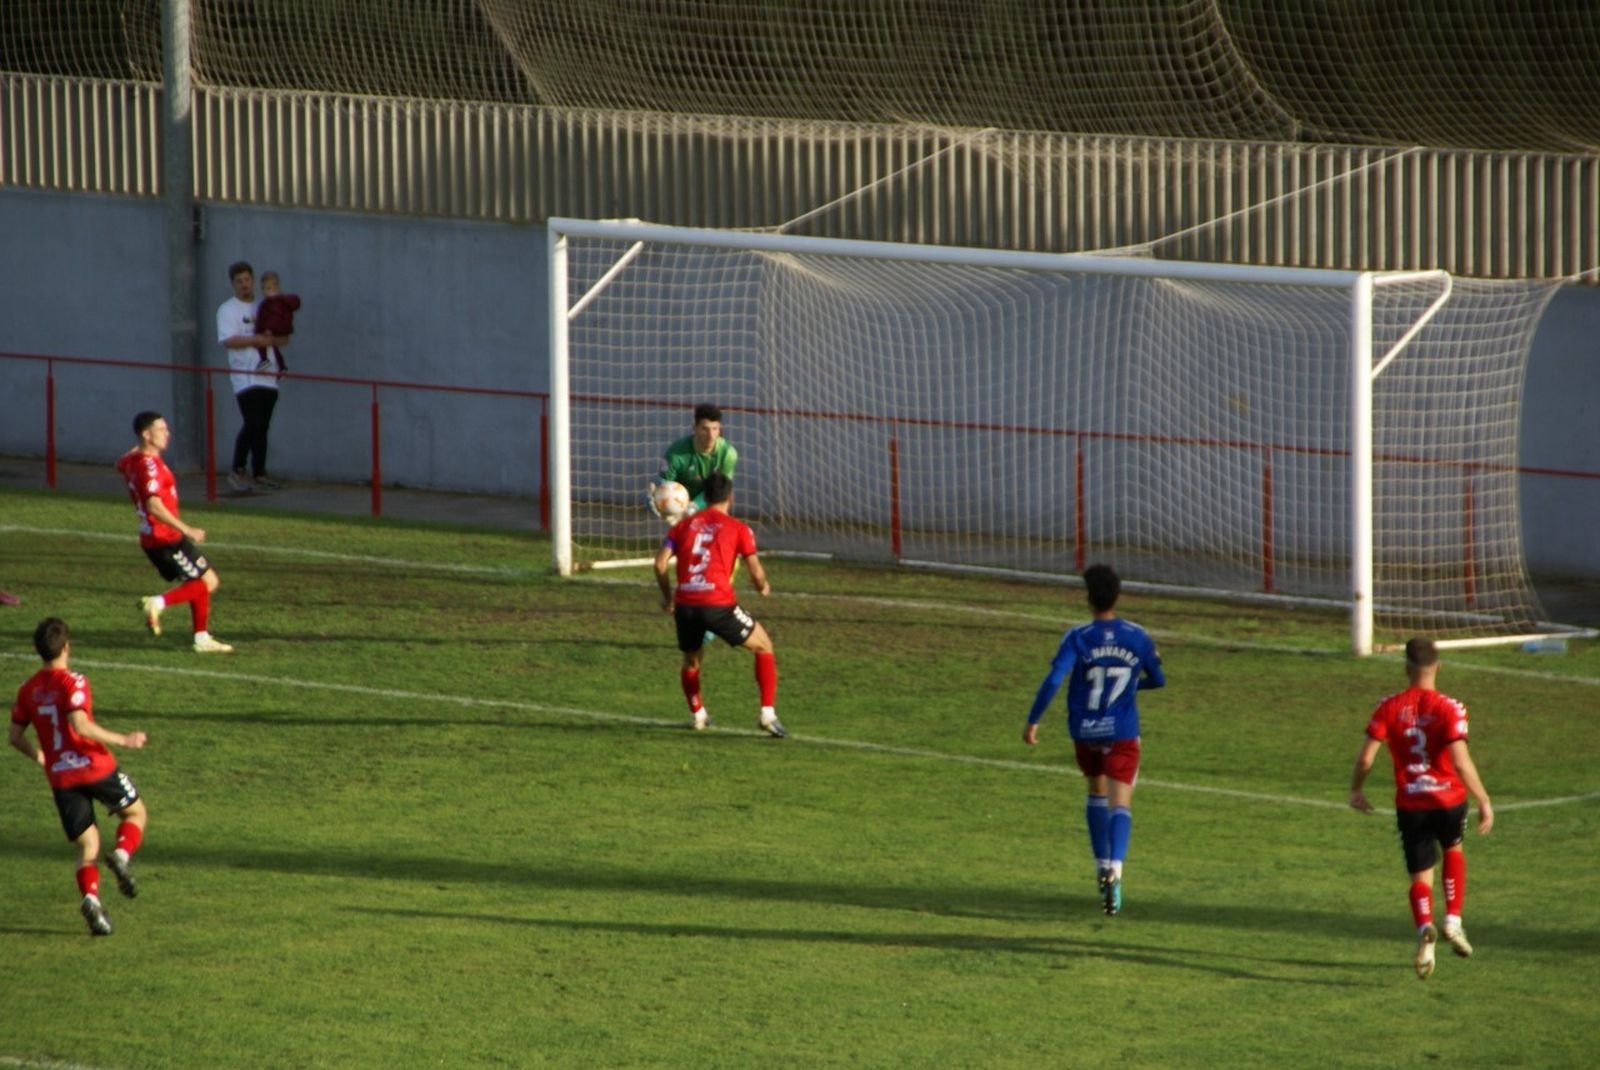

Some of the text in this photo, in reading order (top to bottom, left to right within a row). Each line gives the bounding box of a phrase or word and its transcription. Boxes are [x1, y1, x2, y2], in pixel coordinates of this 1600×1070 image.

[688, 533, 714, 574] 5
[1086, 666, 1133, 711] 17
[37, 704, 62, 751] 7
[1403, 726, 1431, 773] 3
